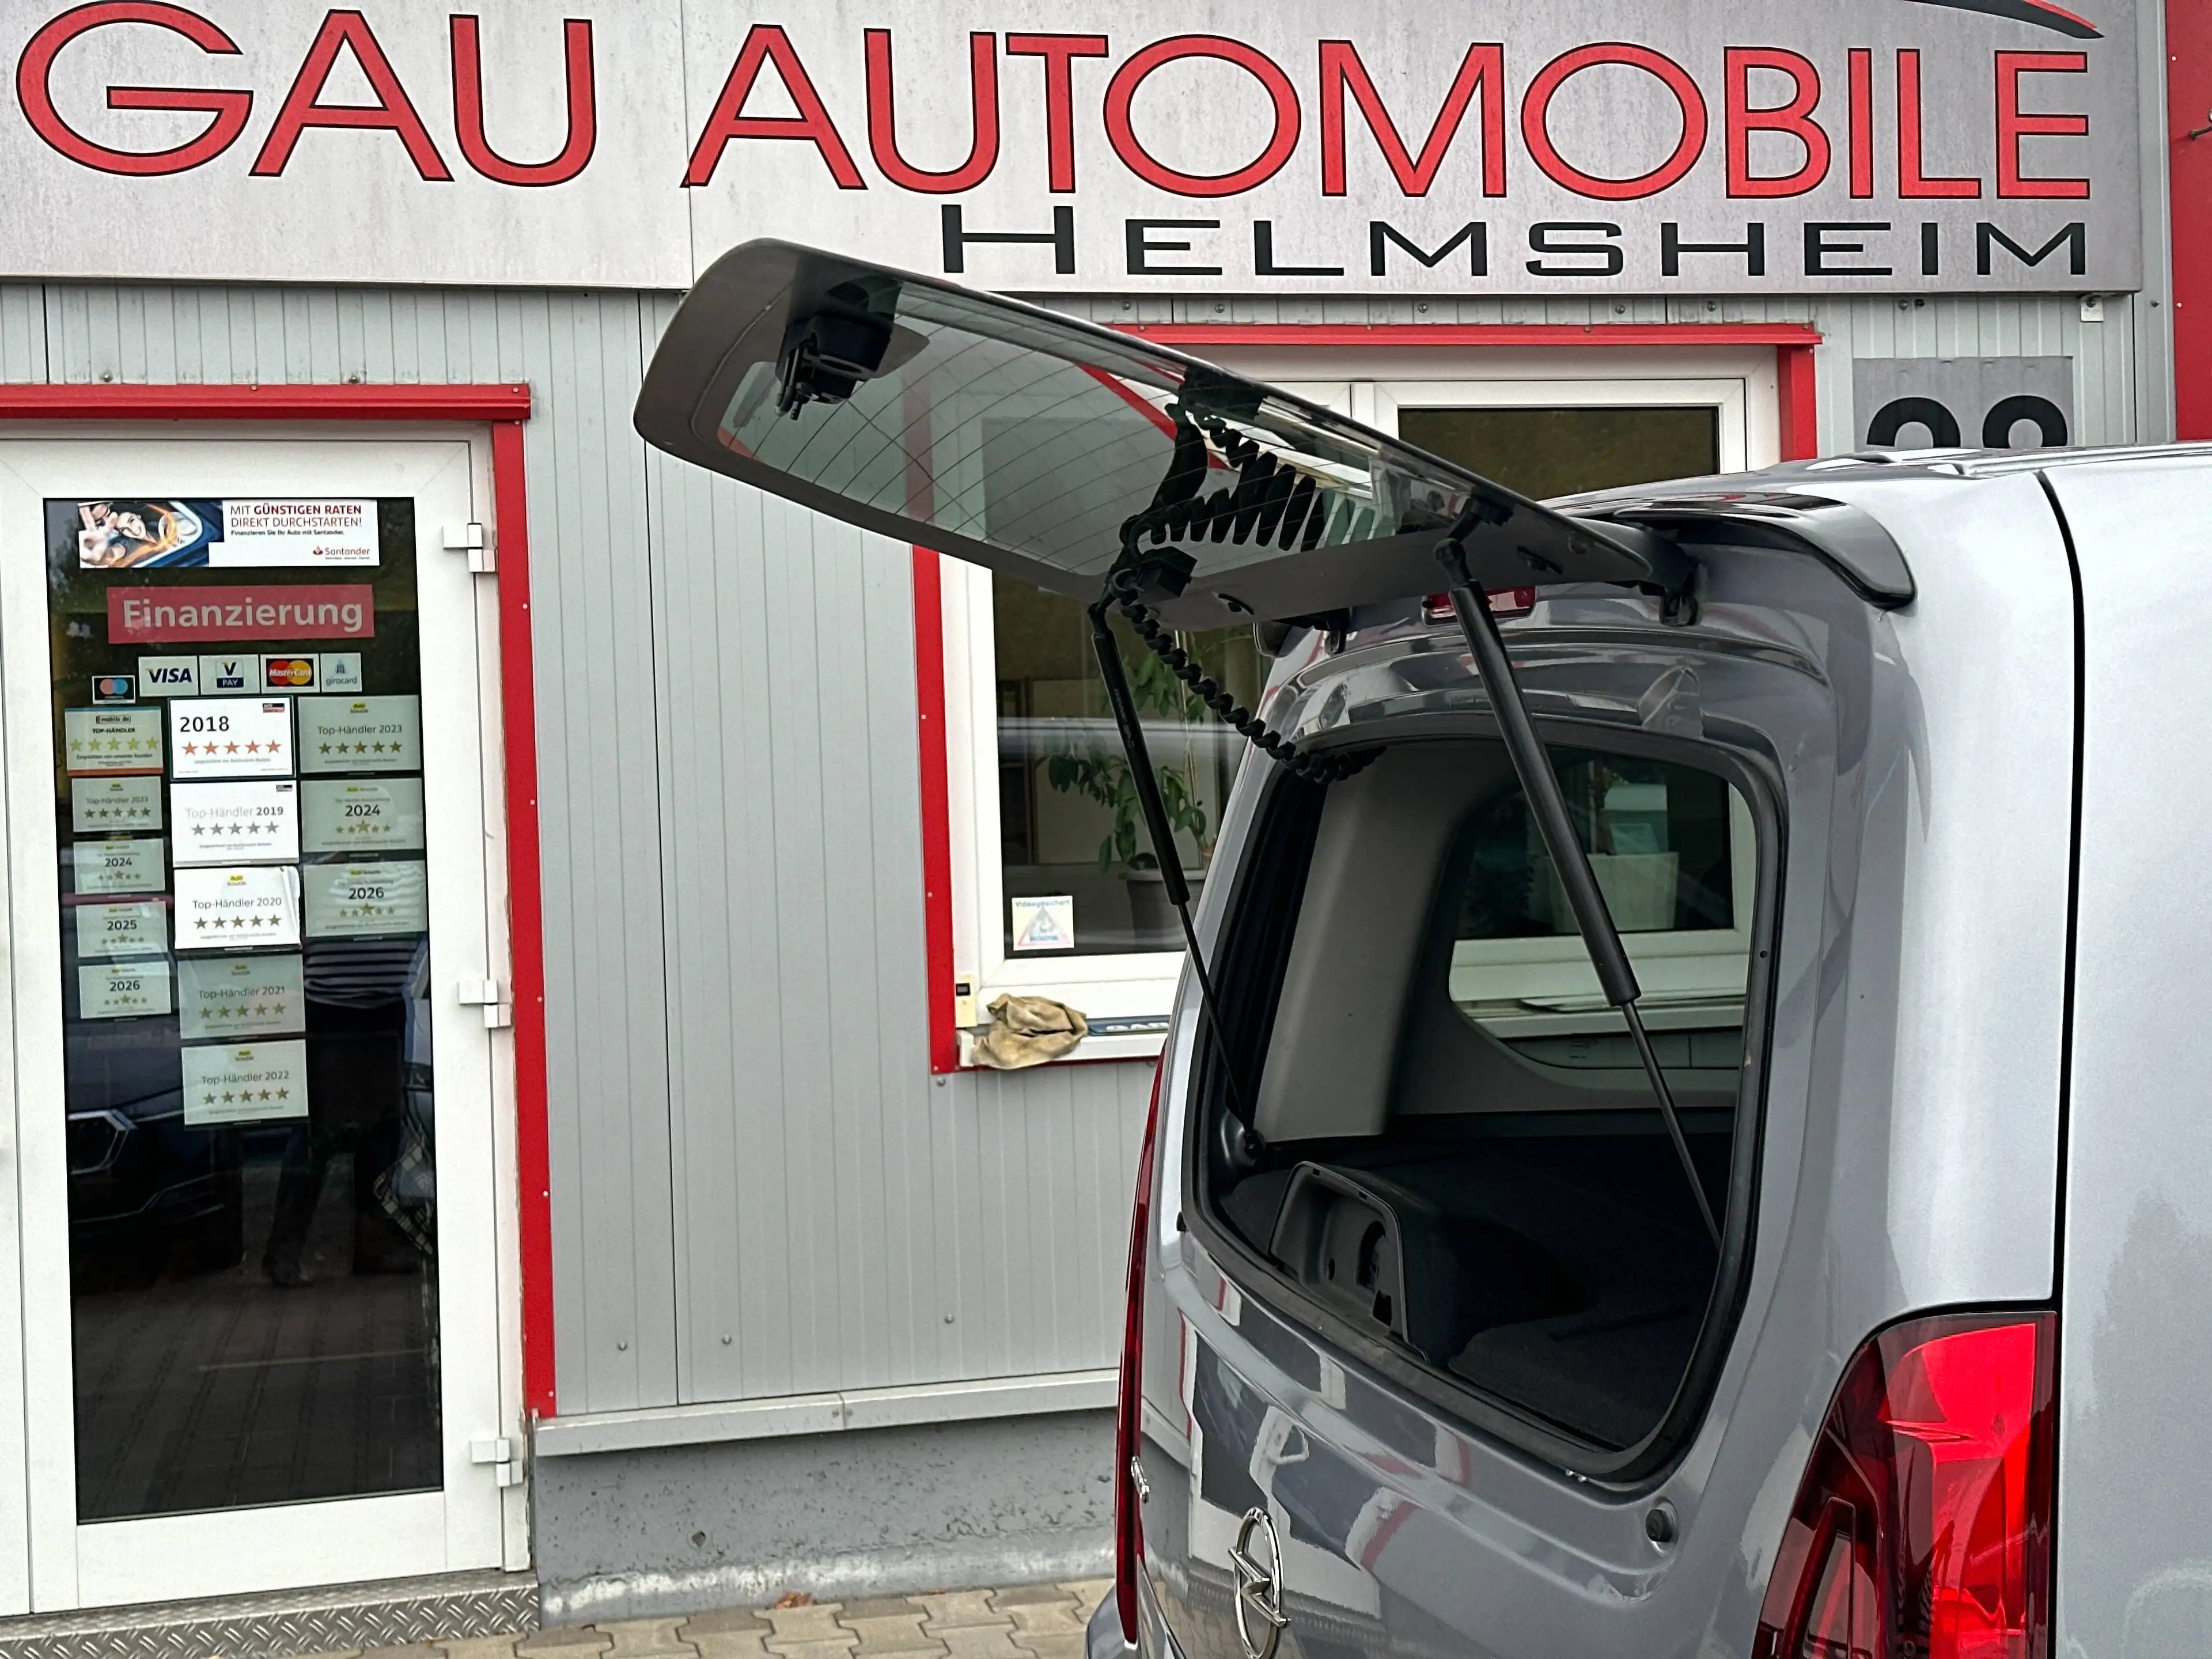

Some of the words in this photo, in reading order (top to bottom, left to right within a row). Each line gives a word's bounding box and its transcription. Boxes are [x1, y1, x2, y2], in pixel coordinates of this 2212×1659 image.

[16, 0, 597, 188] GAU
[680, 24, 2090, 202] AUTOMOBILE
[941, 204, 2087, 278] HELMSHEIM
[230, 505, 251, 516] MIT
[253, 502, 321, 515] GÜNSTIGEN
[325, 505, 362, 514] RATEN
[230, 517, 269, 527] DIREKT
[272, 516, 362, 527] DURCHSTARTEN!
[324, 547, 371, 556] Santander
[123, 597, 363, 632] Finanzierung
[146, 668, 192, 684] VISA
[269, 668, 311, 677] MasterCard
[222, 678, 238, 687] PAY
[325, 676, 358, 687] girocard
[180, 715, 230, 733] 2018
[318, 725, 377, 736] Top-Händler
[378, 724, 402, 733] 2023
[86, 797, 130, 805] Top-Händler
[185, 807, 253, 819] Top-Händler
[256, 806, 283, 816] 2019
[344, 804, 381, 817] 2024
[104, 857, 132, 868] 2024
[348, 887, 384, 900] 2026
[192, 899, 254, 910] Top-Händler
[257, 897, 282, 907] 2020
[107, 919, 137, 931] 2025
[109, 980, 140, 992] 2026
[198, 988, 259, 1000] Top-Händler
[262, 986, 285, 995] 2021
[201, 1073, 263, 1085] Top-Händler
[265, 1070, 289, 1081] 2022
